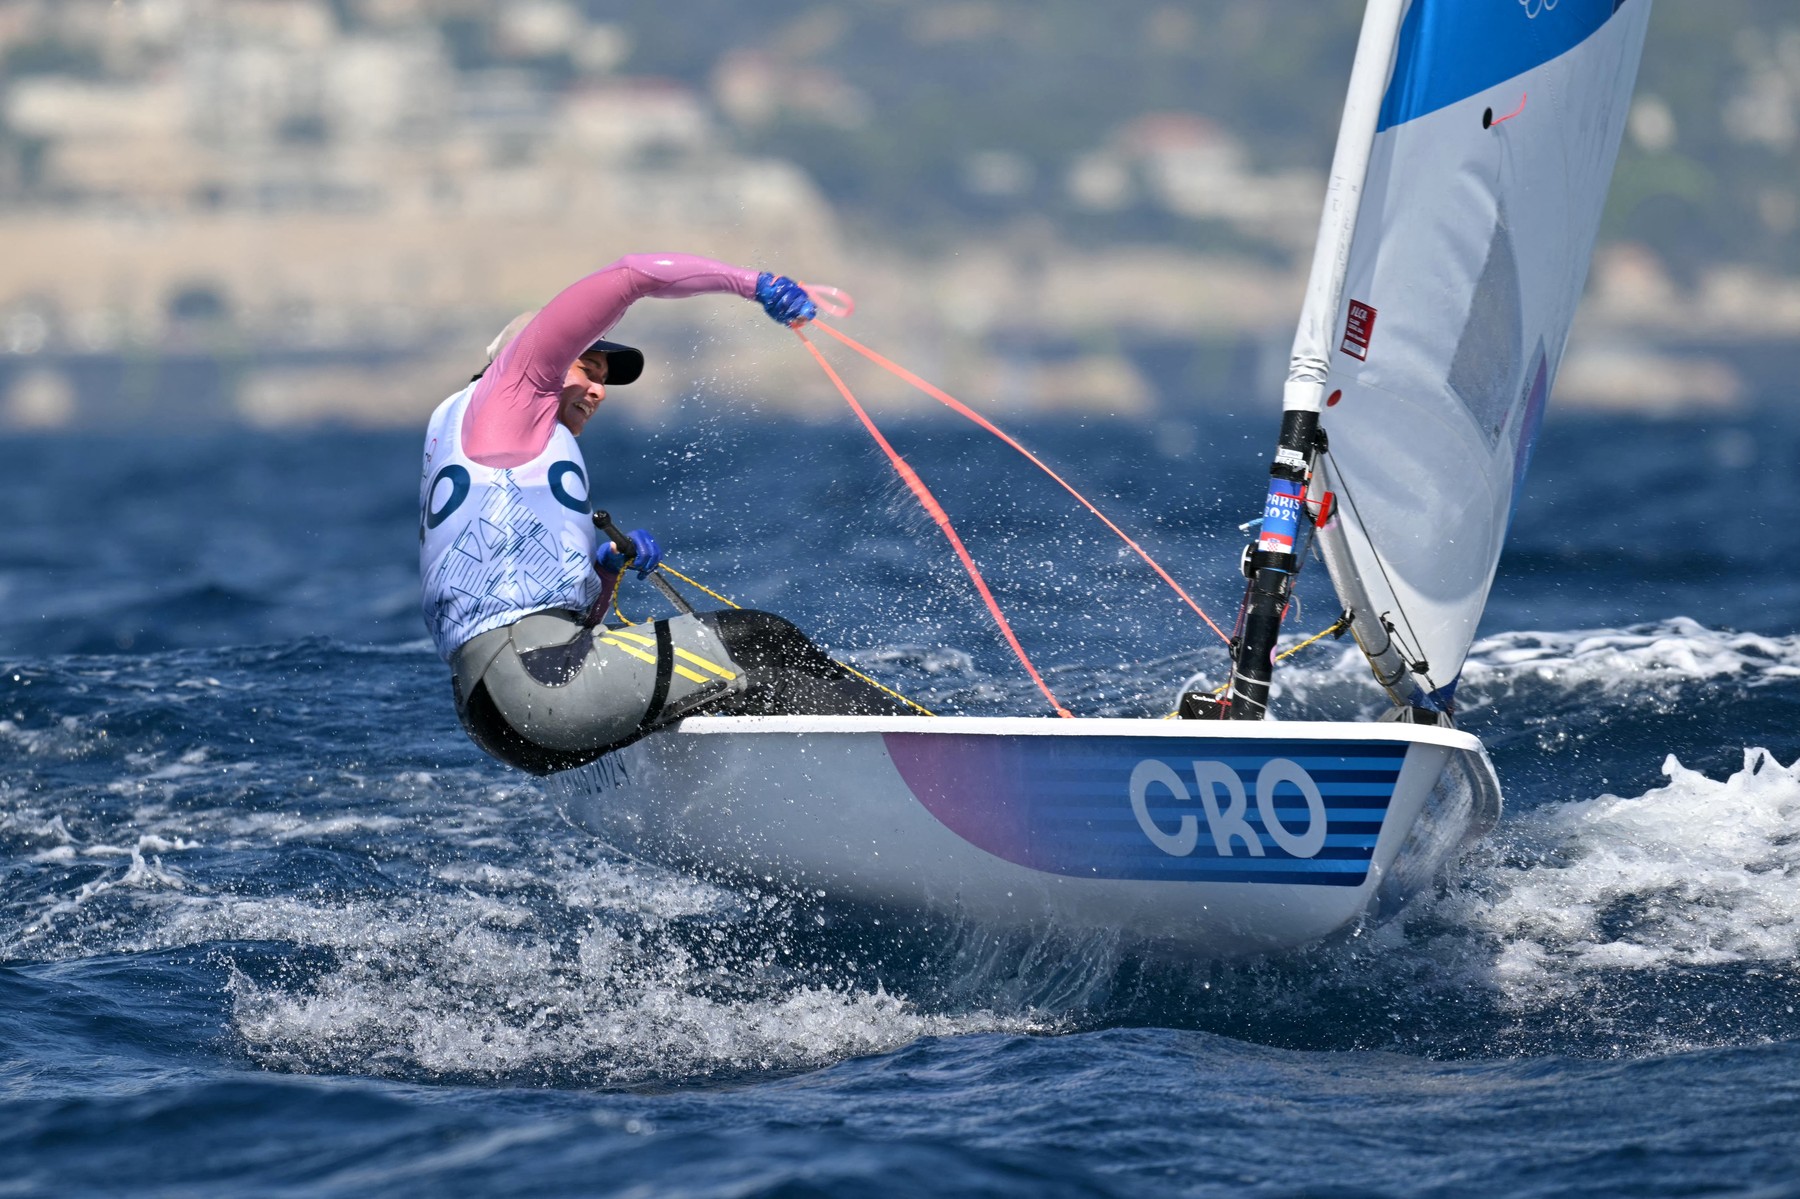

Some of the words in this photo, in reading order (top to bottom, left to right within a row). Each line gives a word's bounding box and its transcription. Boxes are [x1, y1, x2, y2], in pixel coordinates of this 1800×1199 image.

[1265, 493, 1301, 511] PARIS
[1263, 505, 1299, 523] 2024
[1129, 757, 1328, 859] CRO
